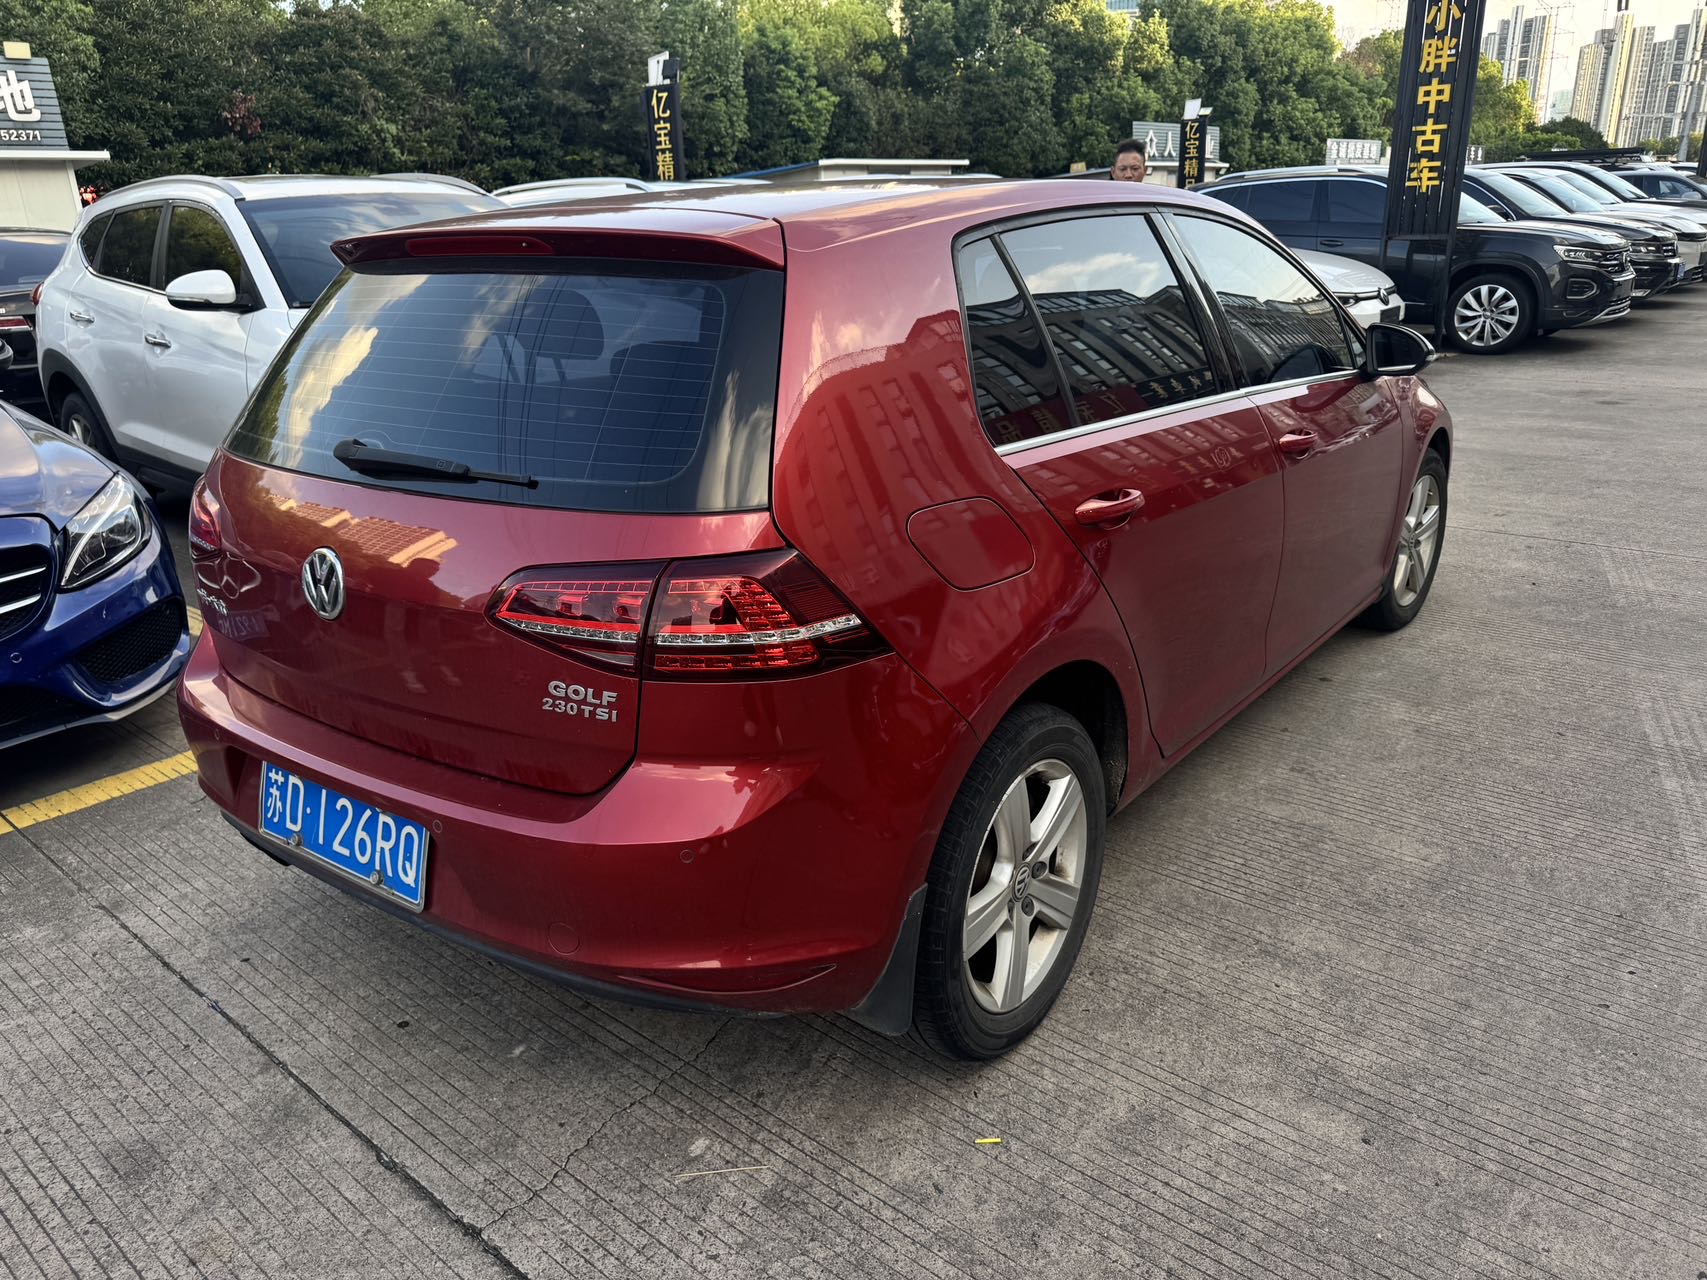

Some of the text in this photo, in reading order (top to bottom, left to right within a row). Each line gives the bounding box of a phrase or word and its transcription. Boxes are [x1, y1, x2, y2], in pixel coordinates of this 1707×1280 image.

[1406, 0, 1461, 193] 小胖中古车
[0, 129, 41, 141] 52371
[651, 88, 675, 181] 亿宝精
[547, 680, 618, 706] GOLF
